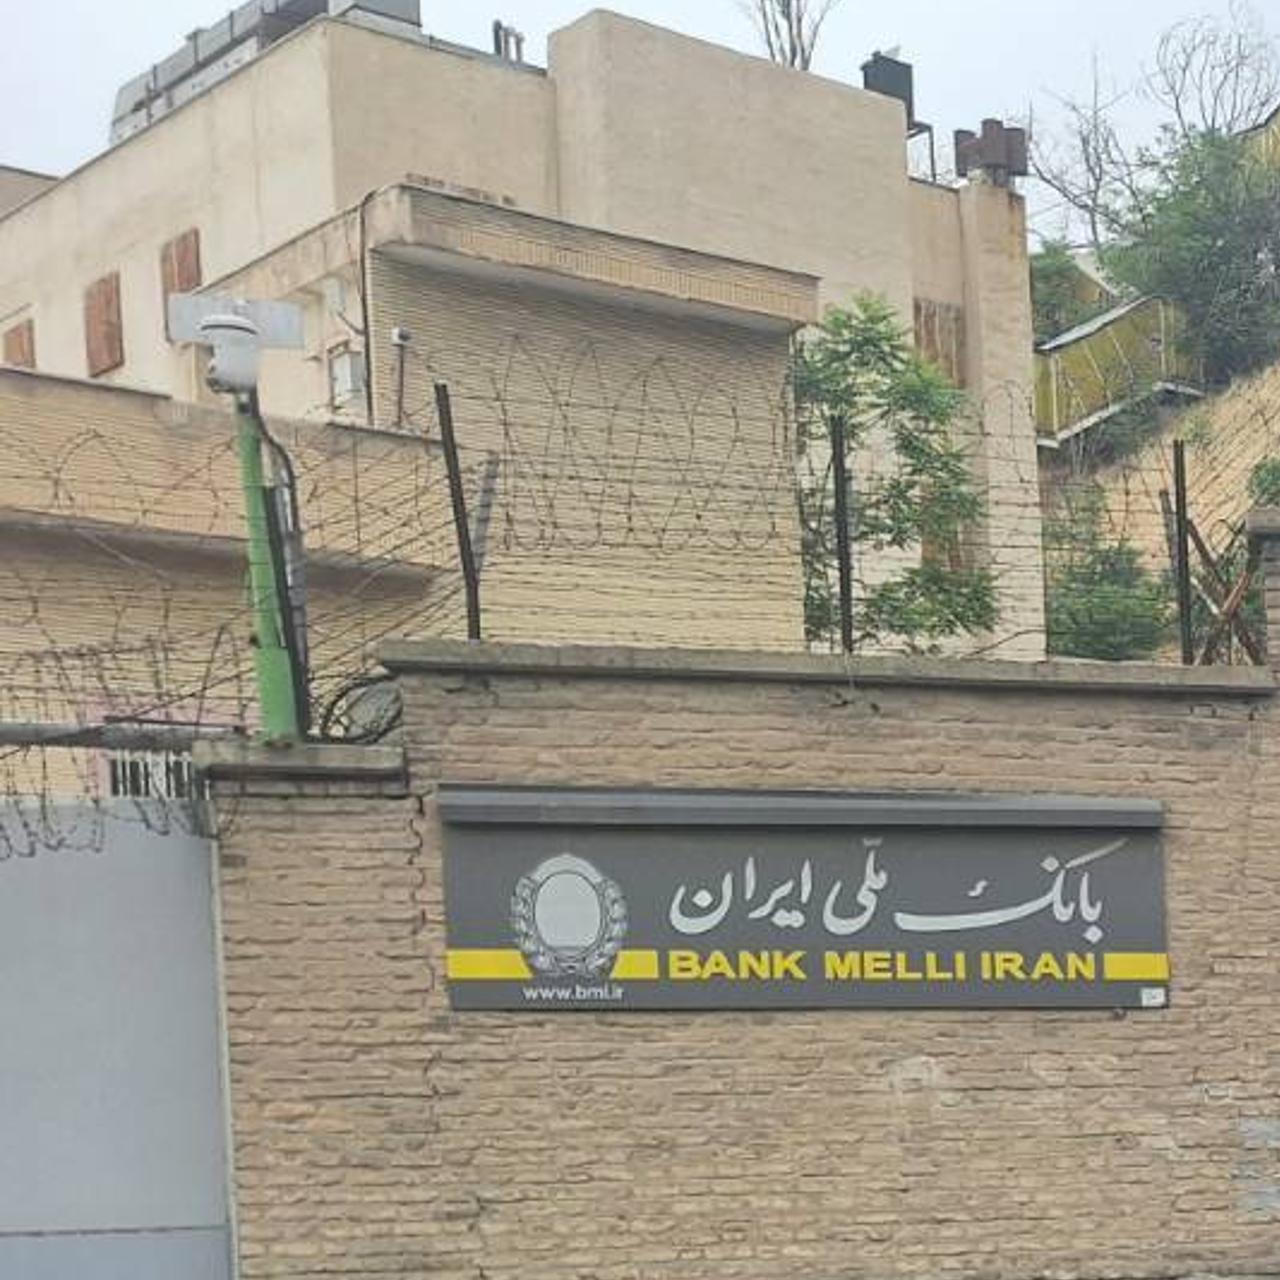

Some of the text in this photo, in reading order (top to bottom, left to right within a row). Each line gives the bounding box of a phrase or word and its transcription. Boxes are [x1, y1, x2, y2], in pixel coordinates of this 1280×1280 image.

[668, 855, 814, 935] ایران
[668, 950, 1096, 981] BANK MELLI IRAN
[521, 983, 624, 1001] www.bmi.ir
